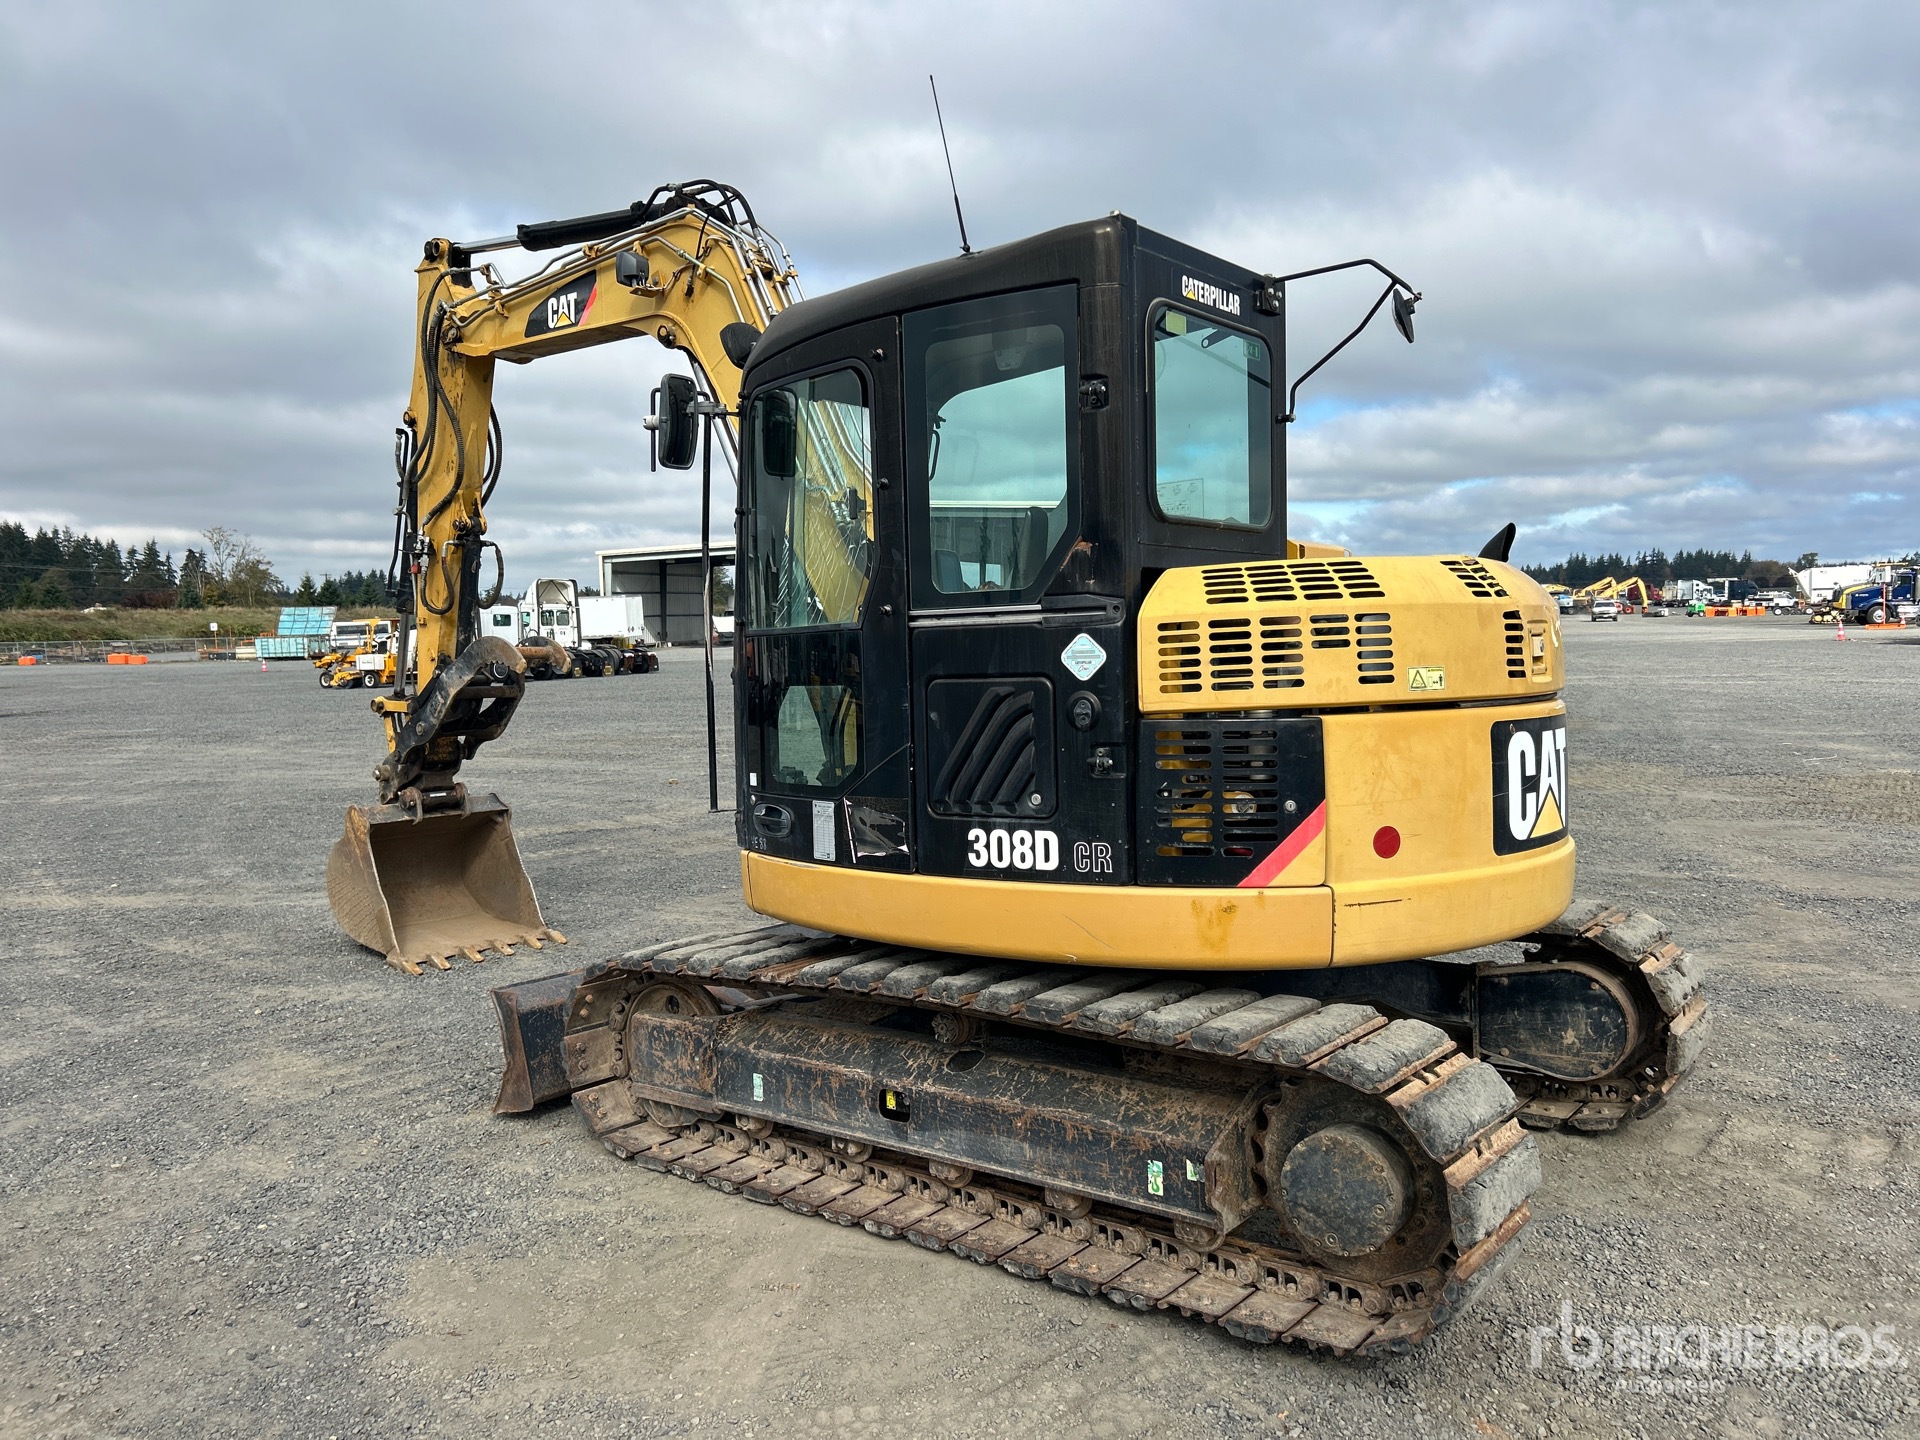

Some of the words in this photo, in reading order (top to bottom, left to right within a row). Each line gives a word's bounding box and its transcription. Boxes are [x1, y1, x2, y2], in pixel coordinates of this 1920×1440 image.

[547, 292, 577, 328] CAT
[1181, 275, 1240, 316] CATERPILLAR
[1508, 727, 1566, 841] CAT
[967, 828, 1059, 871] 308D
[1073, 842, 1113, 873] CR
